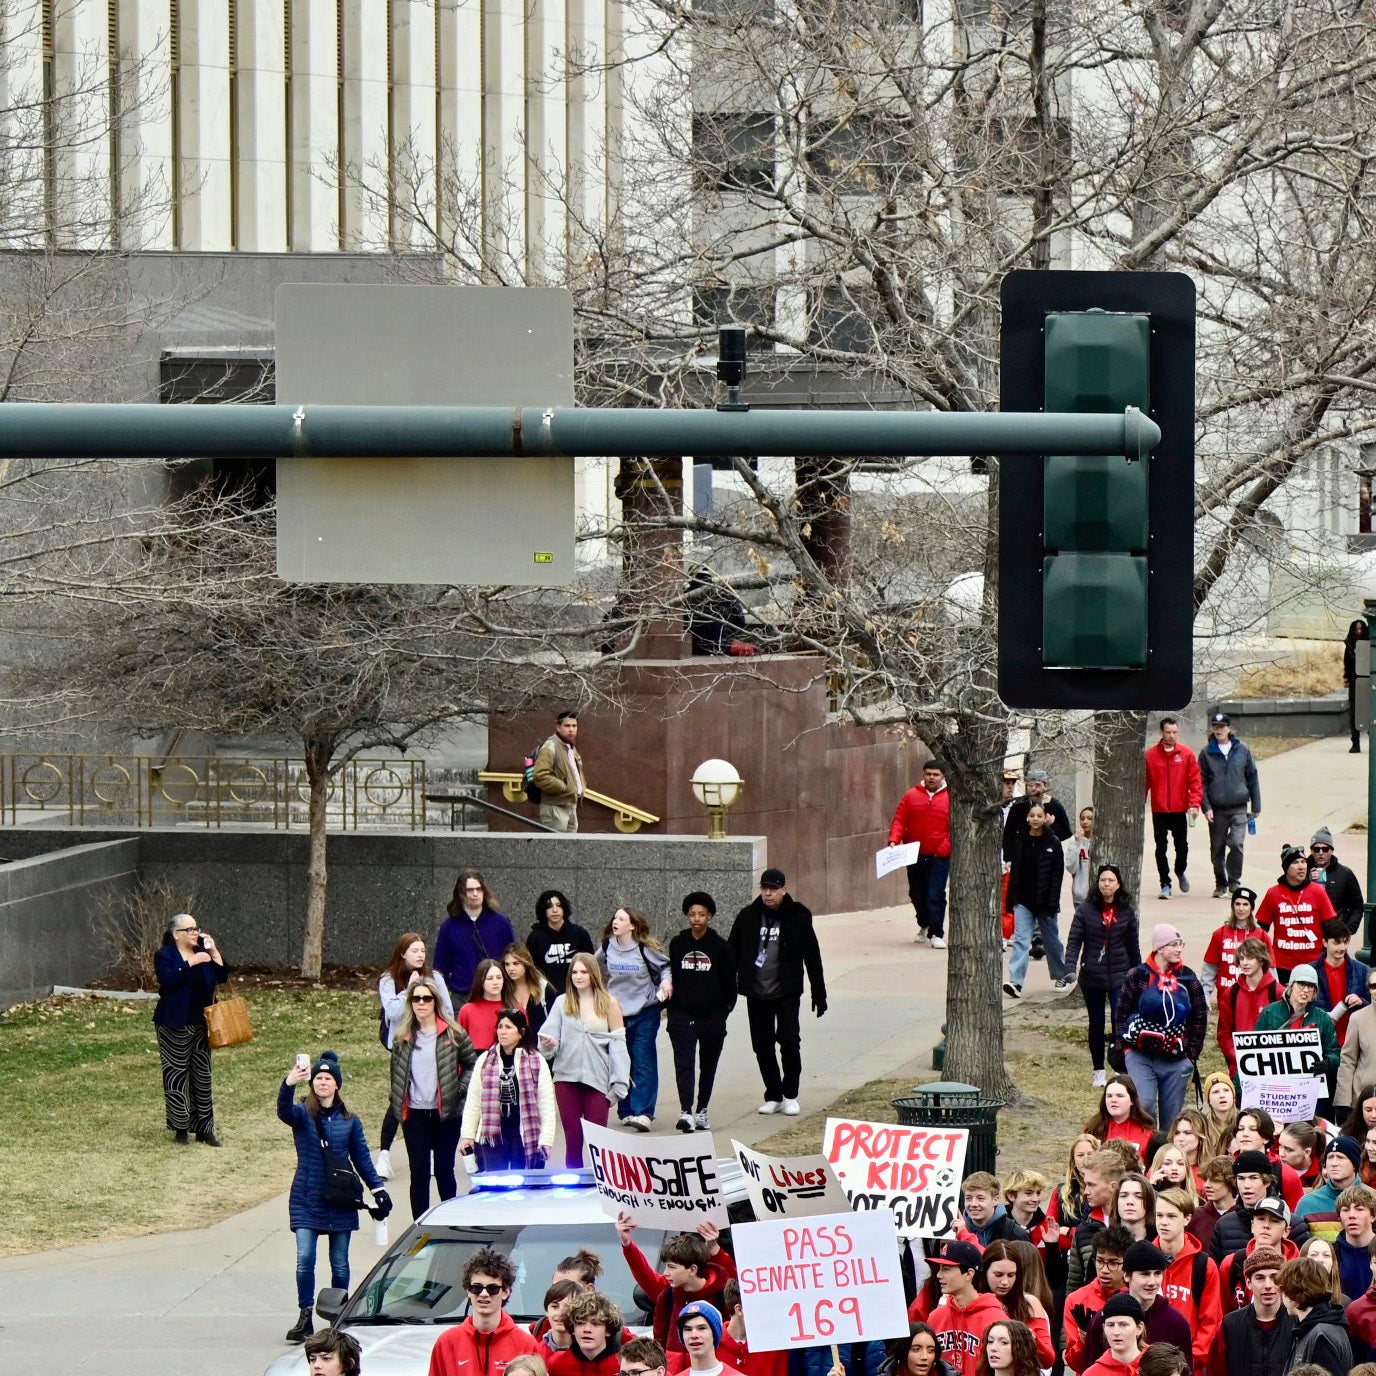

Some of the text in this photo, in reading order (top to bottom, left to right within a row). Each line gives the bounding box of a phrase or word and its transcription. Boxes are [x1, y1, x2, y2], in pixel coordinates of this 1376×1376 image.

[1235, 1032, 1319, 1046] NOT ONE MORE
[1239, 1051, 1320, 1076] CHILD
[829, 1123, 963, 1163] PROTECT
[867, 1163, 933, 1192] KIDS
[597, 1183, 639, 1207] ENOUGH
[783, 1226, 853, 1259] PASS
[741, 1258, 889, 1293] SENATE BILL
[789, 1298, 863, 1341] 169
